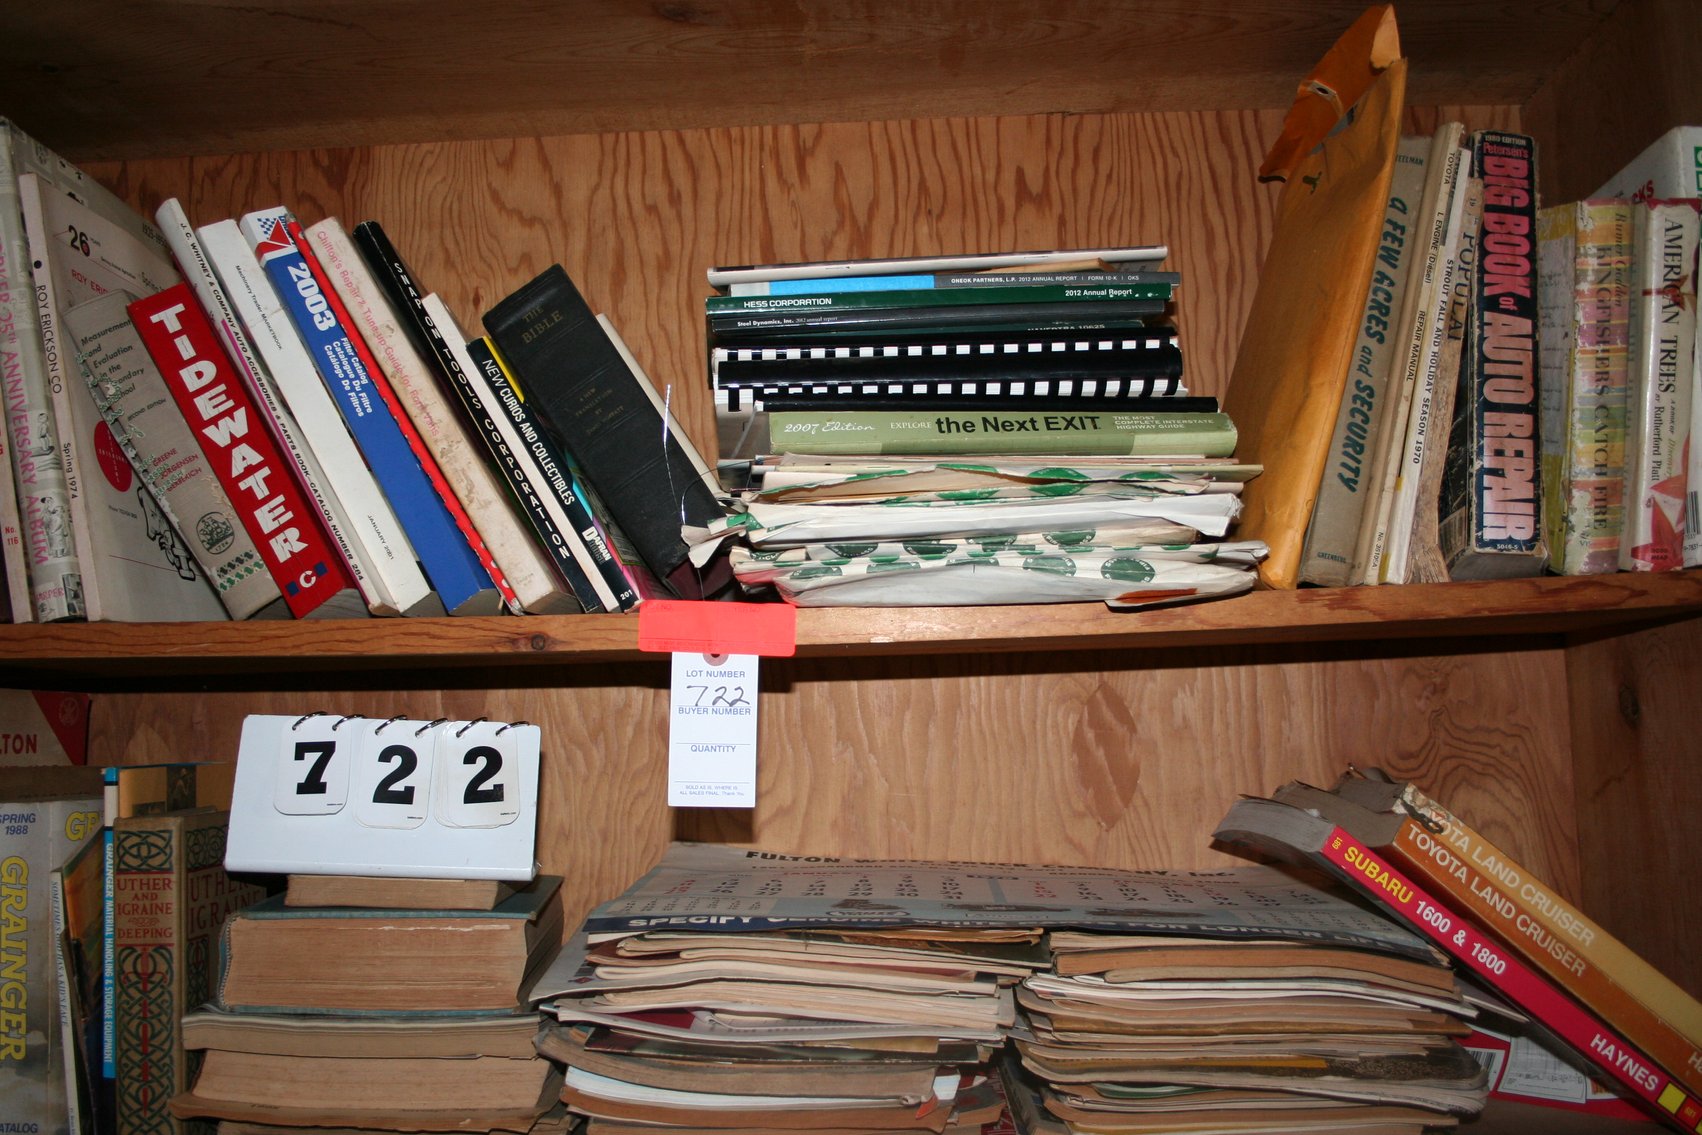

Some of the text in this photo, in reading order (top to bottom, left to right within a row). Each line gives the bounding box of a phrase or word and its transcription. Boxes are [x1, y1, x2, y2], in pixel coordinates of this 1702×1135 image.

[1483, 142, 1529, 158] Petersen's
[1502, 136, 1526, 146] EDITION
[1443, 152, 1456, 185] TOYOTA
[68, 224, 91, 257] 26
[1377, 218, 1406, 270] FEW
[1430, 218, 1444, 251] ENGINE
[317, 231, 343, 270] Chilton's
[342, 267, 362, 301] Repair
[951, 276, 972, 284] ONEOK
[1018, 275, 1031, 283] 2012
[1031, 275, 1055, 283] ANNUAL
[1424, 252, 1437, 284] (Diesel)
[235, 265, 283, 351] Machinery Trader MARKETBOOK
[287, 262, 337, 332] 2003
[743, 297, 832, 309] HESS CORPORATION
[1065, 288, 1133, 298] 2012 Annual Report
[1365, 270, 1396, 345] ACRES
[1658, 217, 1684, 393] AMERICAN TREES
[36, 284, 62, 395] ROY ERICKSON CO
[80, 319, 132, 347] Measurement
[521, 305, 564, 345] THE BIBLE
[737, 320, 752, 328] Steel
[752, 318, 783, 327] Dynamics,
[783, 317, 795, 325] Inc.
[1413, 310, 1426, 342] REPAIR
[93, 345, 134, 370] Evaluation
[341, 337, 369, 385] Filter Catalog
[1356, 345, 1374, 378] and
[1405, 344, 1420, 382] MANUAL
[1412, 259, 1454, 464] STROUT FALL AND HOLIDAY SEASON 1970
[1483, 156, 1535, 540] BIG BOOK of AUTO REPAIR
[108, 363, 122, 375] the
[332, 341, 373, 414] Catalogue Du Filtre
[190, 242, 354, 561] WHITNEY COMPANY AUTO ACCESSORIES PARTS NUMBER
[341, 379, 365, 418] De Filtros
[394, 262, 571, 560] SNAP ON TOOLS CORPORATION
[149, 303, 308, 564] TIDEWATER
[482, 358, 576, 506] NEW CURIOS AND COLLECTIBLES
[784, 420, 875, 436] 2007 Edition
[890, 415, 1101, 434] EXPLORE the Next EXIT
[1337, 378, 1375, 493] SECURITY
[1593, 404, 1609, 478] CATCH
[2, 350, 50, 566] ANNIVERSARY ALBUM
[62, 441, 75, 476] Spring
[152, 447, 178, 468] GREENE
[1650, 405, 1666, 482] Rutherford Platt
[1593, 485, 1608, 530] FIRE
[367, 514, 387, 546] JANUARY
[581, 525, 613, 562] DAFRAN
[686, 670, 746, 678] LOT NUMBER
[678, 706, 752, 716] BUYER NUMBER
[686, 685, 750, 707] 722
[690, 744, 737, 753] QUANTITY
[5, 824, 29, 836] 1988
[745, 850, 841, 864] FULTON
[116, 878, 174, 891] UTHER
[131, 891, 158, 902] AND
[1407, 823, 1468, 885] TOYOTA
[1469, 876, 1517, 920] LAND
[1515, 913, 1588, 979] CRUISER
[1471, 845, 1596, 947] LAND CRUISER
[117, 902, 174, 916] IGRAINE
[117, 927, 174, 940] DEEPING
[627, 915, 754, 928] SPECIFY
[1199, 925, 1325, 939] LONGER
[0, 855, 31, 1062] GRAINGER
[104, 842, 113, 1064] GRAINGER MATERIAL HANDLING STORAGE EQUIPMENT
[1344, 846, 1414, 904] SUBARU
[1415, 900, 1452, 934] 1600
[1452, 929, 1467, 948] &
[1470, 942, 1507, 976] 1800
[1589, 1032, 1660, 1092] HAYNES
